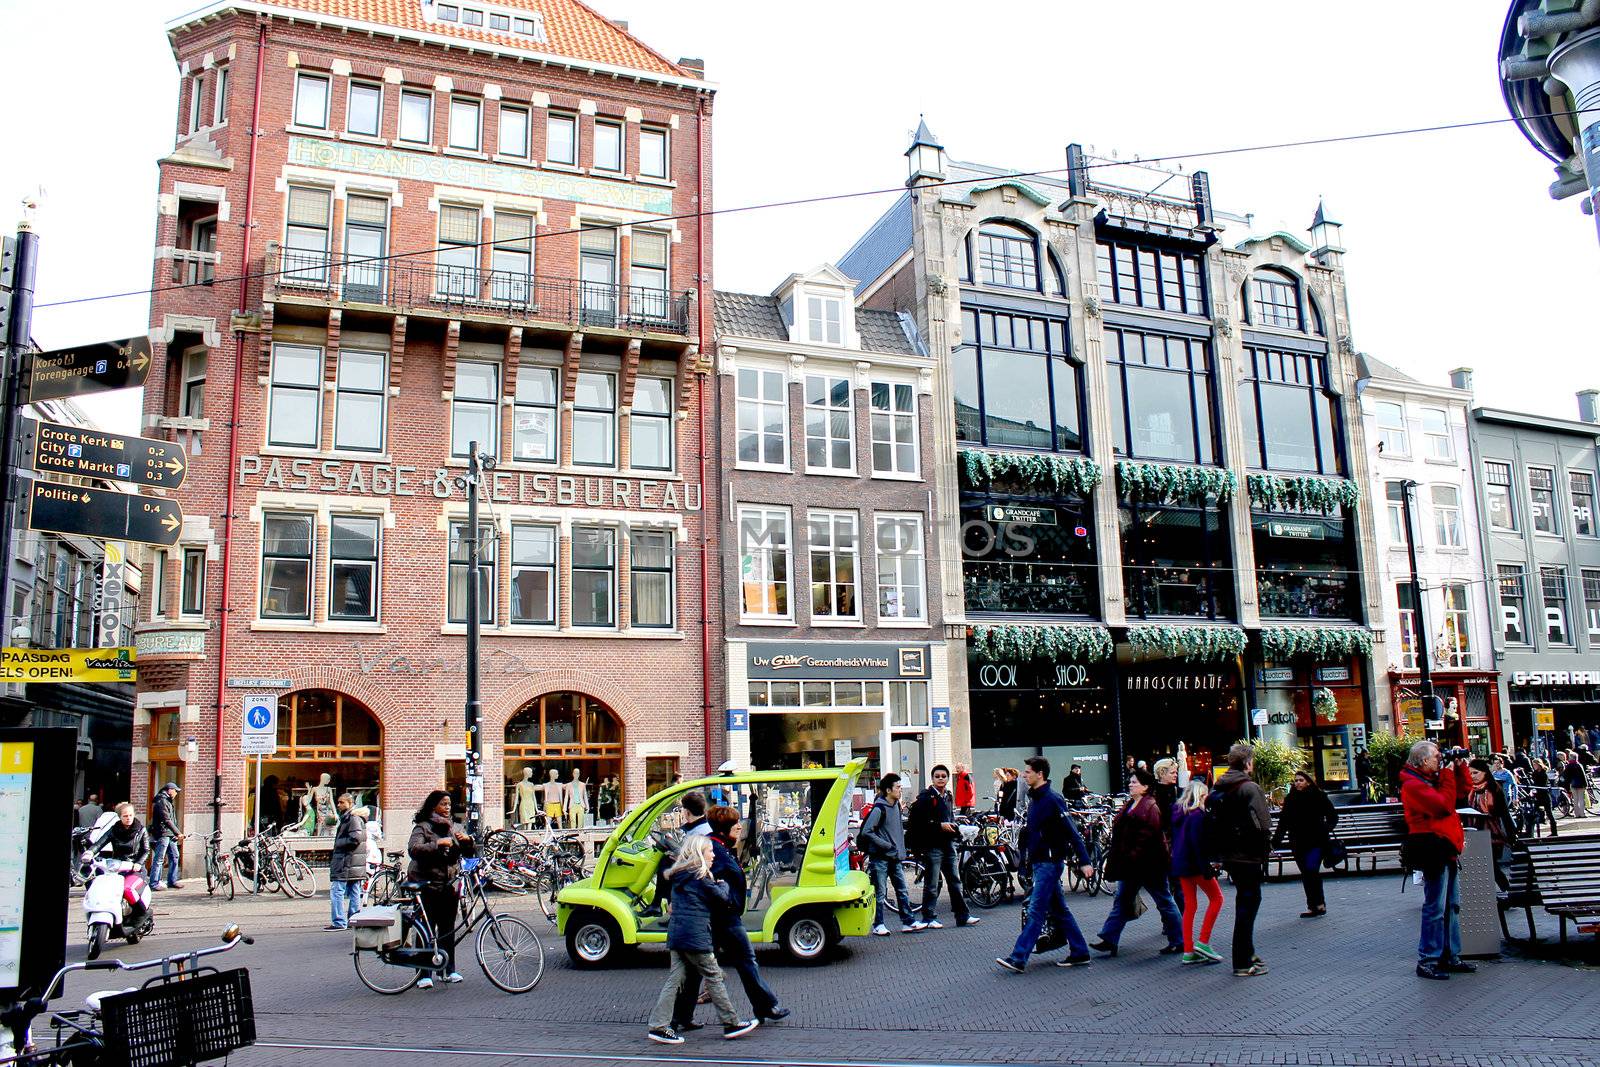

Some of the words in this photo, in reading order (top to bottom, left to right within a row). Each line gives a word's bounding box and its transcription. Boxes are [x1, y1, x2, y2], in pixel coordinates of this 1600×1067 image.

[35, 356, 63, 370] Korzo
[35, 365, 94, 382] Torengarage
[41, 428, 77, 443] Grote
[80, 435, 108, 448] Kerk
[40, 441, 65, 457] City
[39, 454, 75, 468] Grote
[79, 460, 115, 474] Markt
[239, 456, 416, 496] PASSAGE
[432, 468, 453, 498] &
[37, 487, 79, 502] Politie
[1011, 515, 1038, 523] TWITTER
[101, 563, 122, 647] xenos
[2, 652, 71, 664] PAASDAG
[352, 641, 546, 675] Vaniia
[753, 656, 769, 667] Uw
[771, 654, 808, 669] G&W
[807, 656, 889, 667] GezondheidsWinkel
[29, 667, 73, 678] OPEN!
[979, 664, 1017, 687] COOK
[1055, 664, 1087, 686] SHOP
[1512, 671, 1568, 685] G-STAR
[1127, 675, 1189, 690] HAAGSCHE
[819, 828, 826, 837] 4
